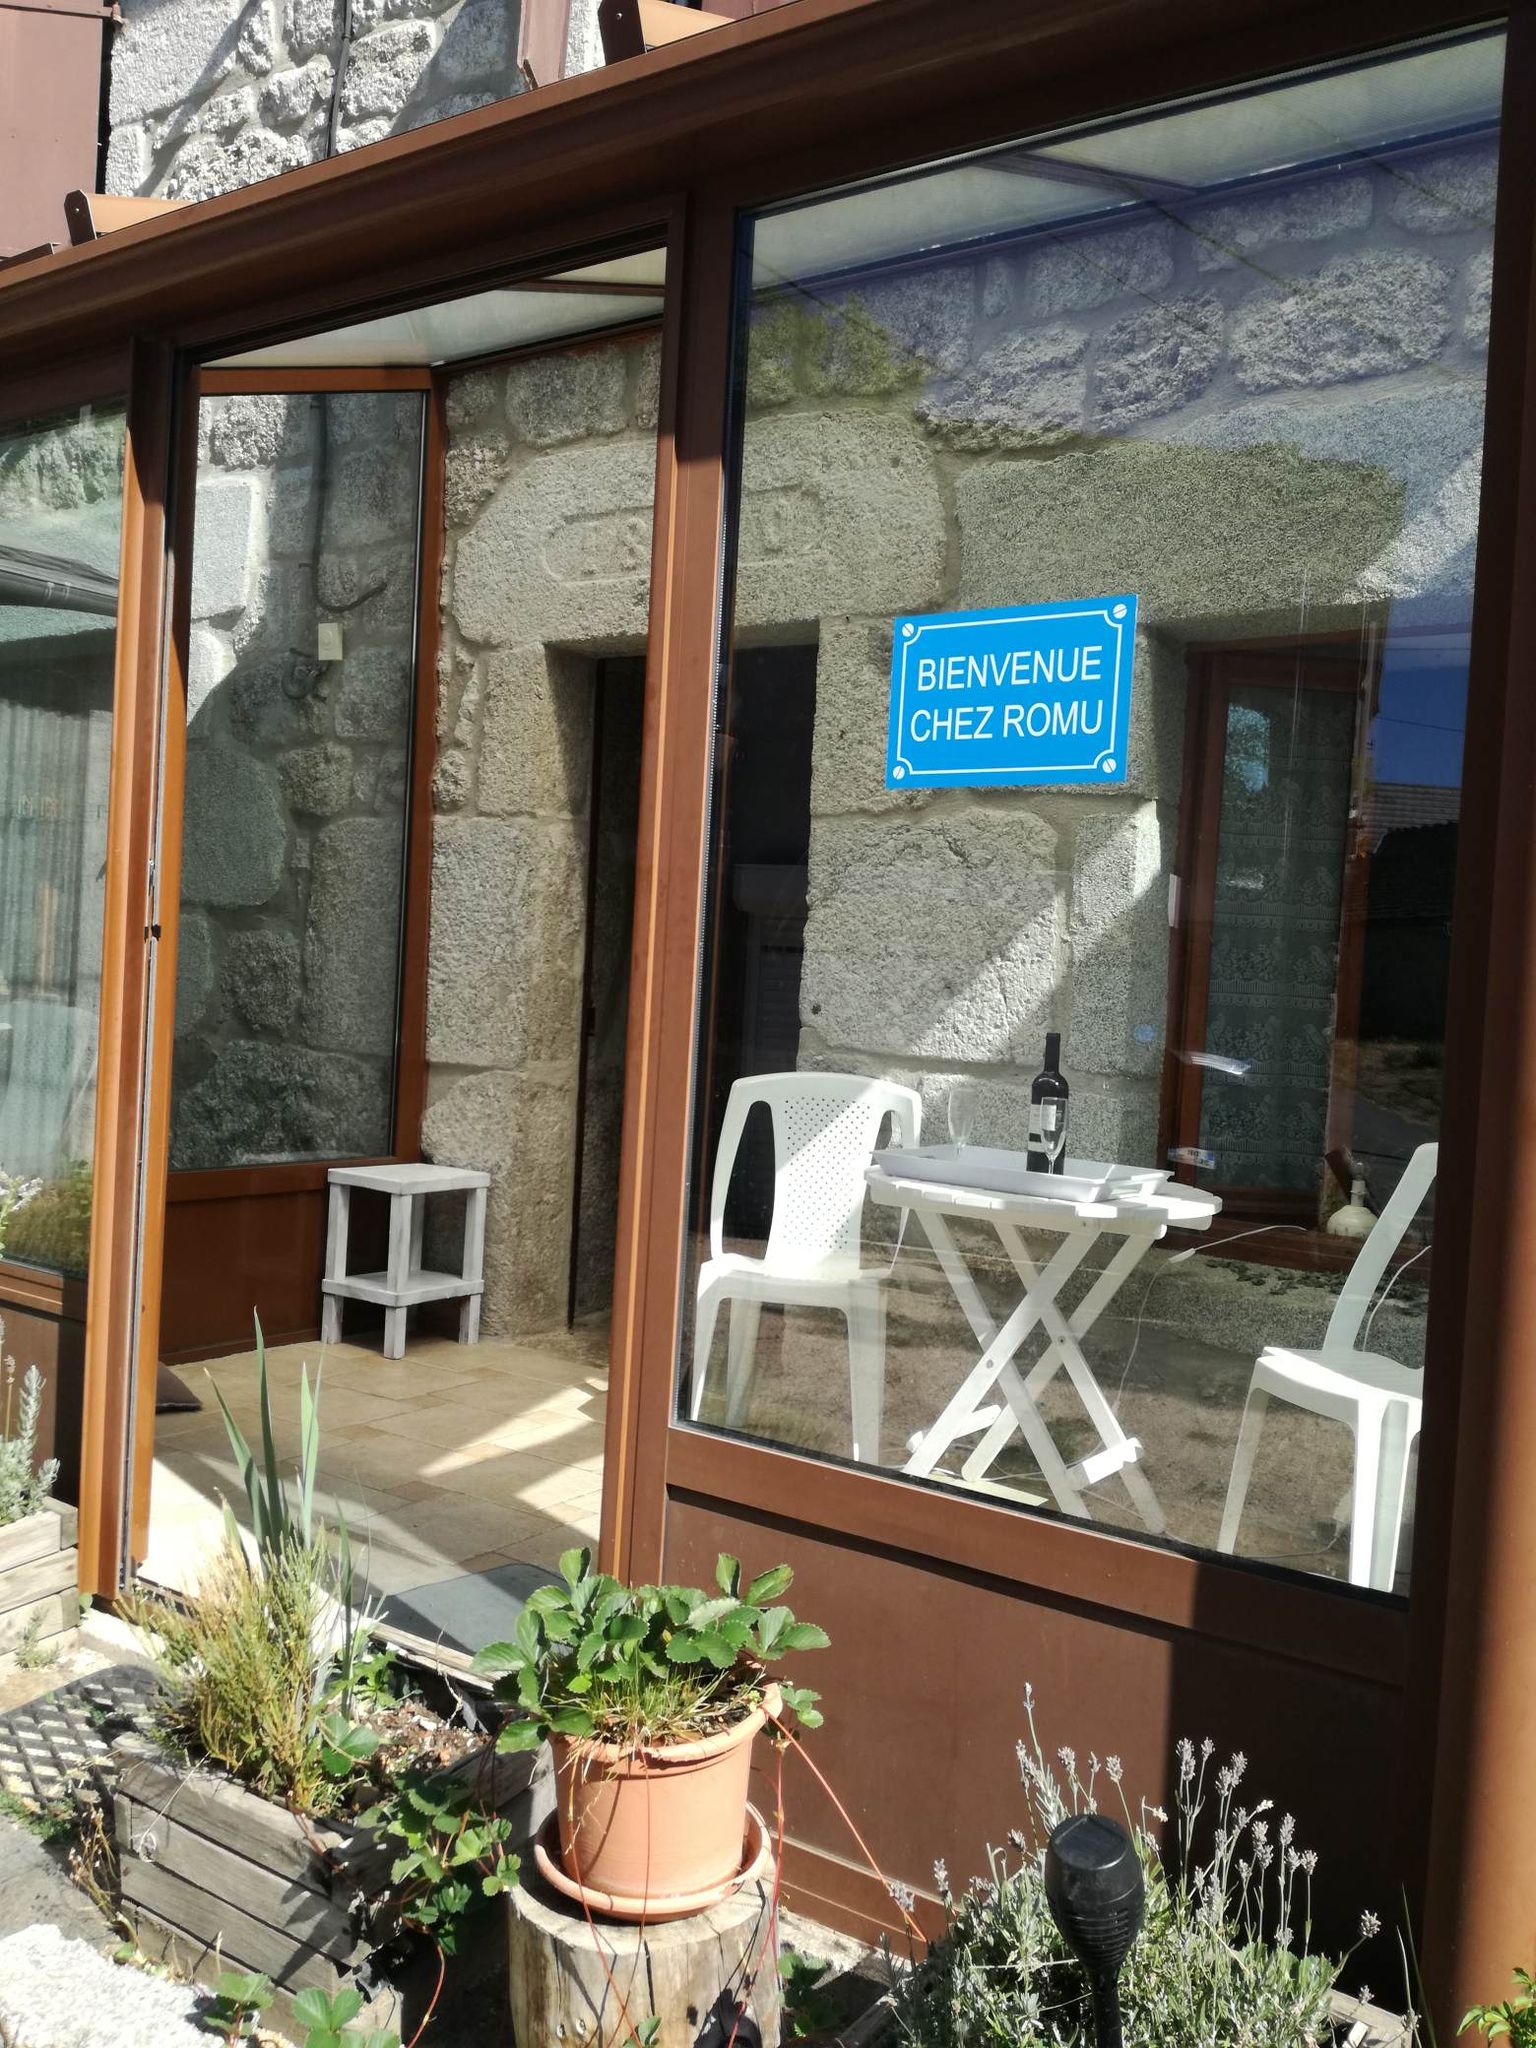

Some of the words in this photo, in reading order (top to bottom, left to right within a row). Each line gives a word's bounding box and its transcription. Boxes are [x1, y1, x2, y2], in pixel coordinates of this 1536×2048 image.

[917, 645, 1103, 691] BIENVENUE
[910, 705, 994, 742] CHEZ
[1003, 699, 1103, 738] ROMU
